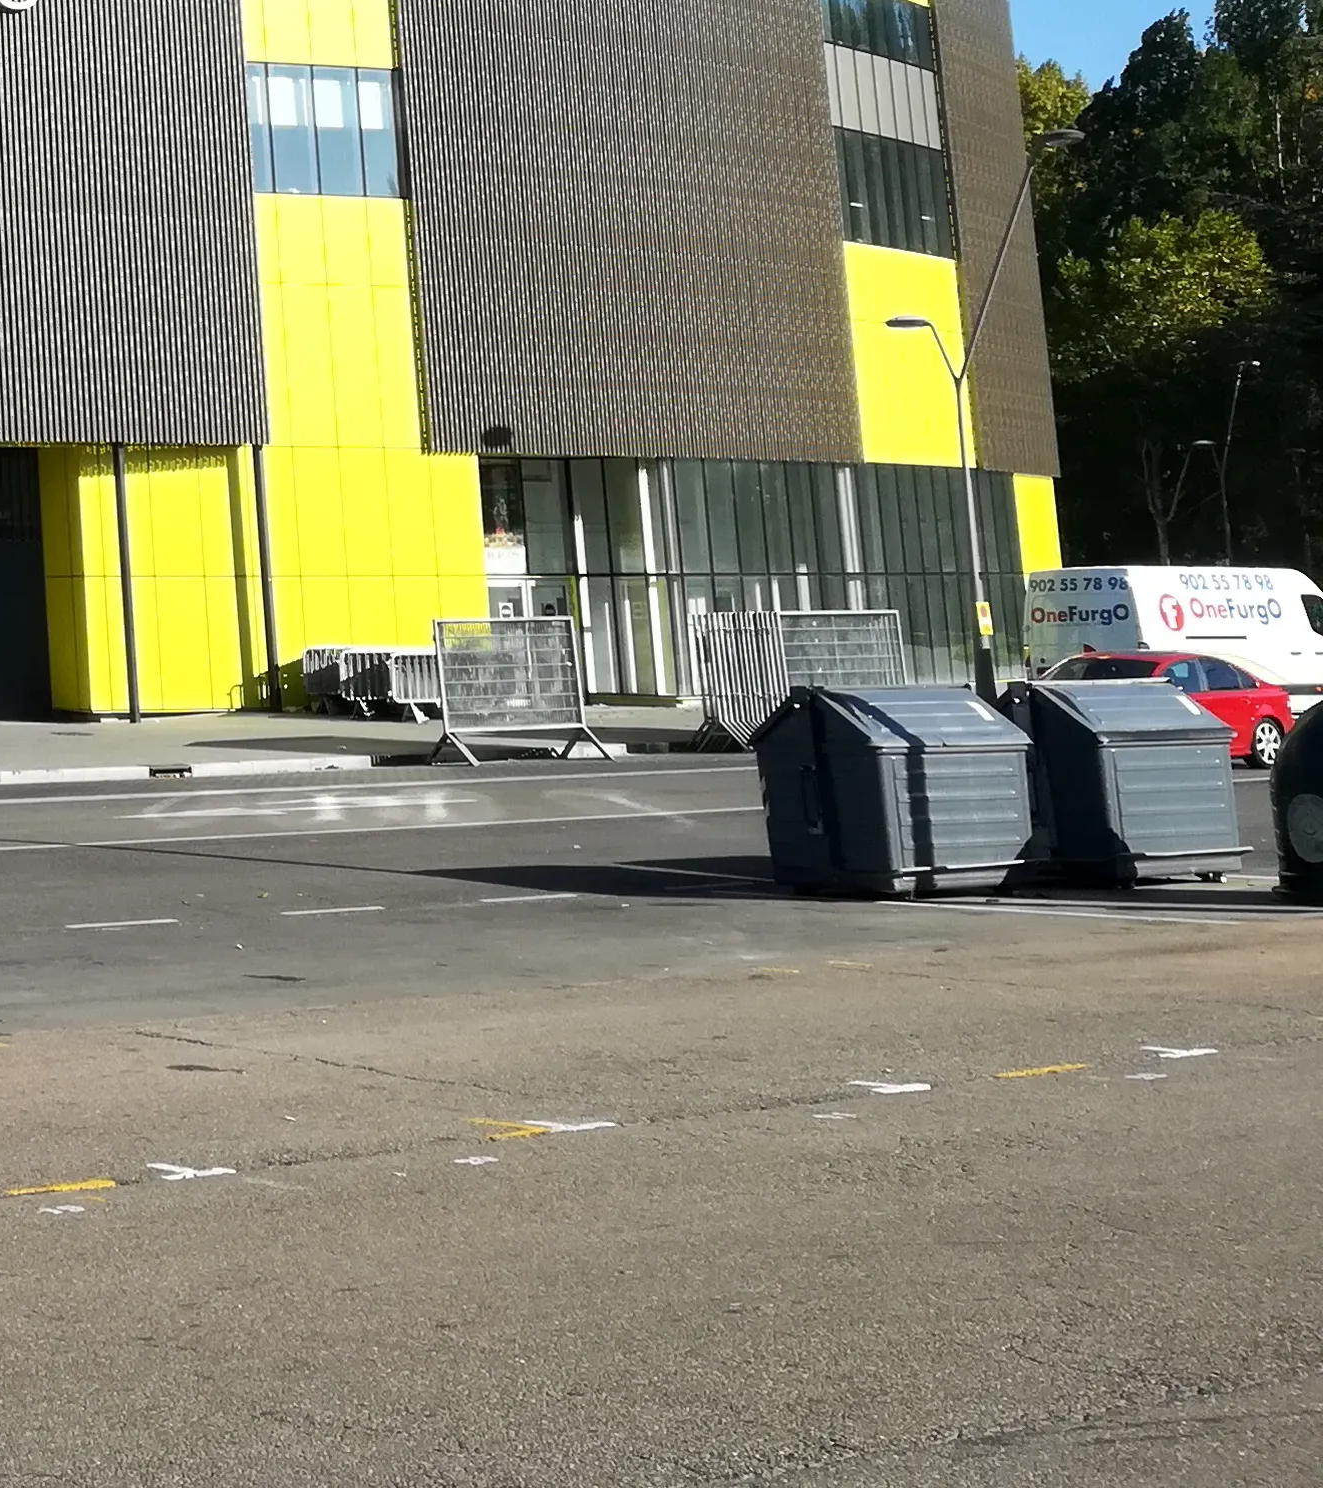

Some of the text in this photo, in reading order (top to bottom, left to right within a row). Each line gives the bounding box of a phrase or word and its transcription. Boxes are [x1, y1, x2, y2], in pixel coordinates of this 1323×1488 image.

[1030, 576, 1129, 592] 902 55 78 98
[1179, 573, 1274, 590] 902 55 78 98
[1031, 603, 1130, 626] OneFurgO
[1190, 597, 1282, 625] OneFurgO
